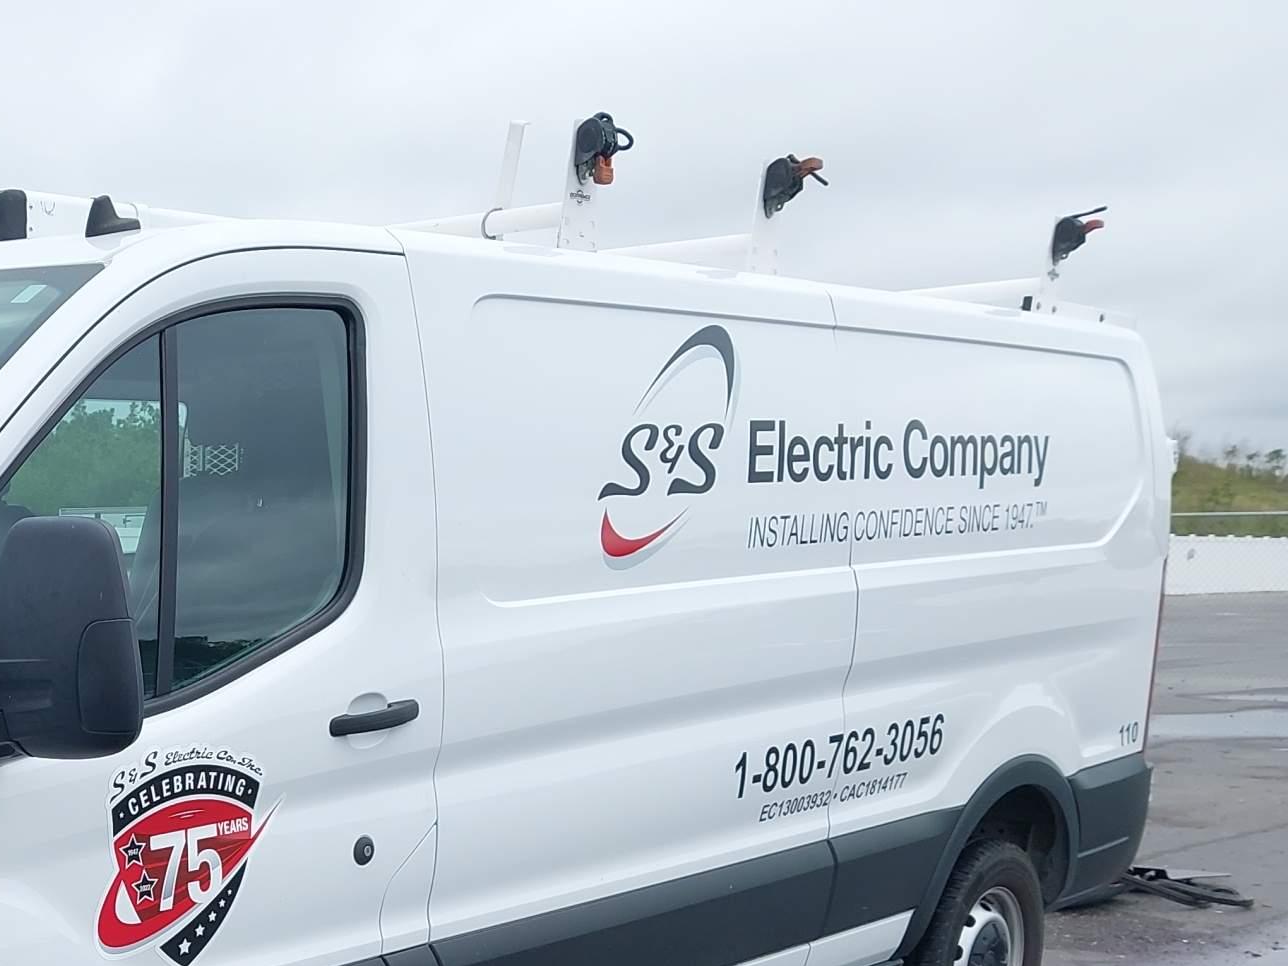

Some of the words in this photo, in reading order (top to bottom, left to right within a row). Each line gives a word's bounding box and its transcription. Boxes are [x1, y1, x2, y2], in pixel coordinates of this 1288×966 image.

[598, 422, 725, 501] S&S
[747, 420, 894, 484] Electric
[903, 418, 1050, 489] Company
[747, 511, 850, 549] INSTALLING
[853, 506, 955, 542] CONFIDENCE
[958, 503, 1001, 534] SINCE
[734, 713, 945, 799] 1-800-762-3056
[1119, 721, 1139, 746] 110
[164, 747, 214, 767] Electric
[237, 757, 263, 777] Inc.
[127, 771, 247, 815] CELEBRATING
[759, 789, 832, 823] EC13003932
[839, 772, 908, 803] CAC1814177
[150, 822, 223, 912] 75
[217, 816, 249, 836] YEARS
